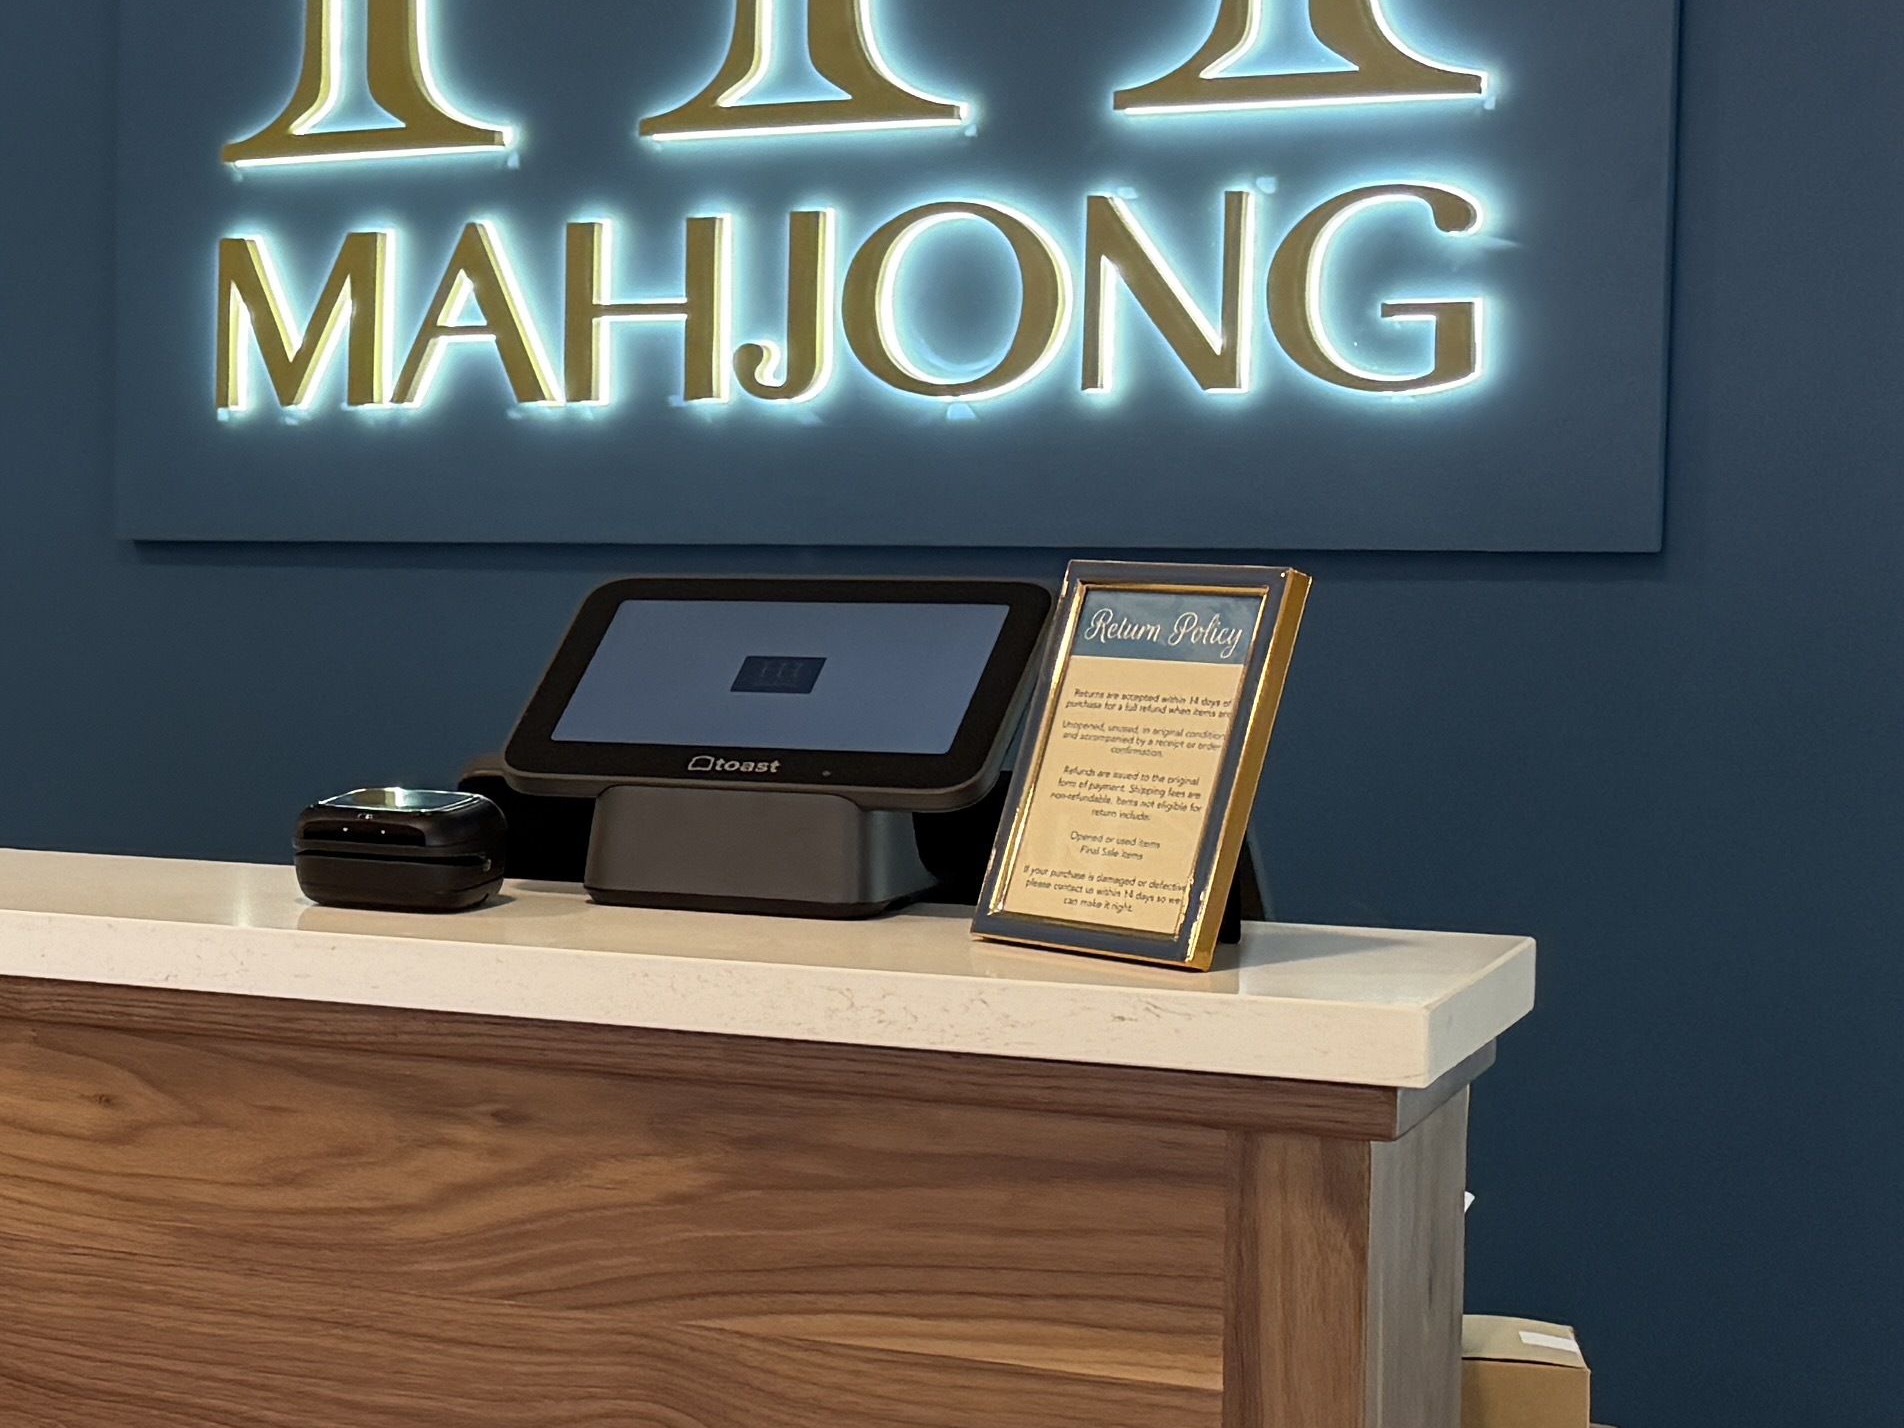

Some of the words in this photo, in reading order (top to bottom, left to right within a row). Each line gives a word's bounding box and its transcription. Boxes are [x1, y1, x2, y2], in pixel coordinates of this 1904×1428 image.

[216, 182, 1492, 414] MAHJONG
[1084, 608, 1161, 643] Return
[1167, 611, 1242, 659] Policy
[715, 758, 781, 773] toast
